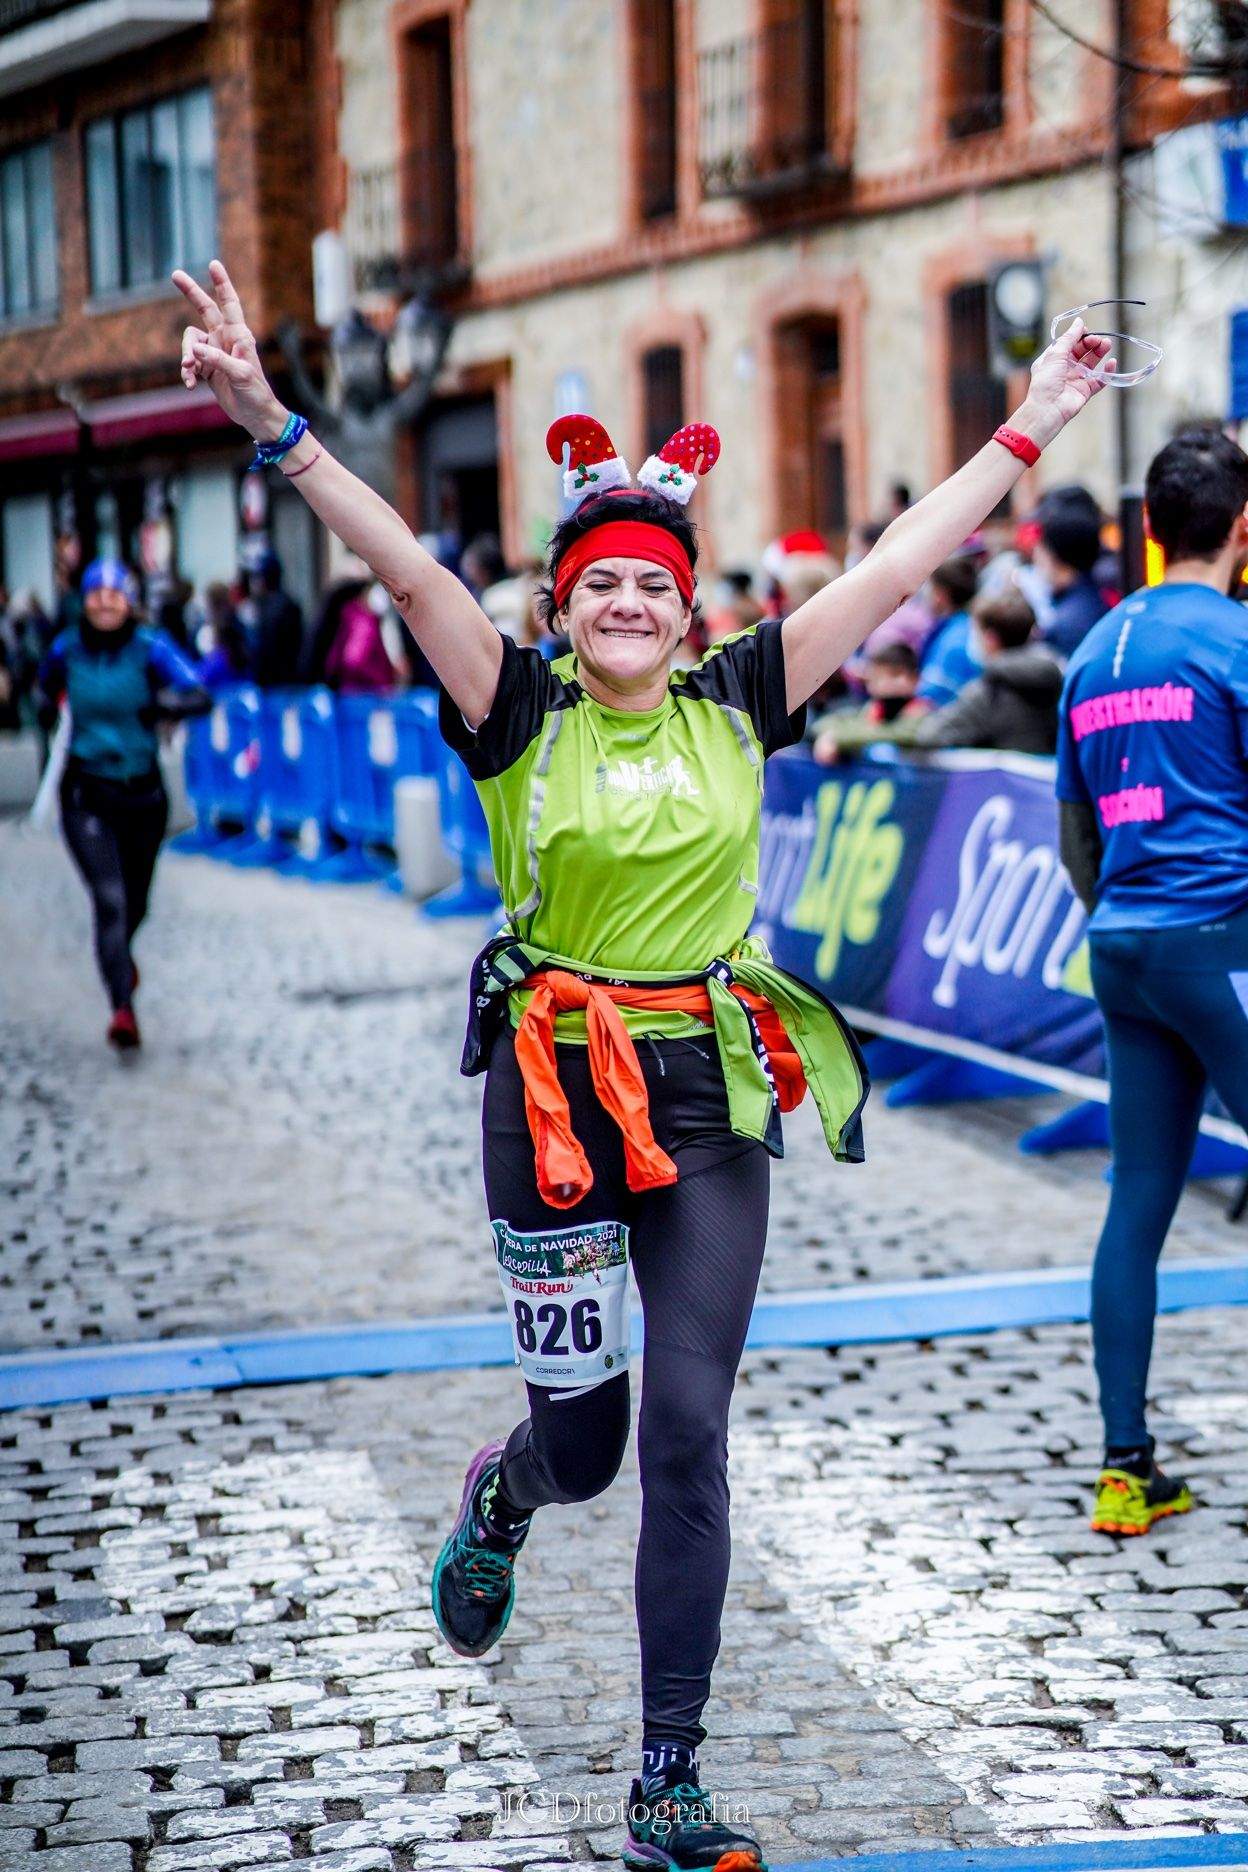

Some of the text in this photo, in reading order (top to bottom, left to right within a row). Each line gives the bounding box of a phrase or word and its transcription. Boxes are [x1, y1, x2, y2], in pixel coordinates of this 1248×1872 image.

[524, 1244, 538, 1253] DE
[540, 1234, 593, 1253] NAVIDAD
[597, 1229, 617, 1242] 2021
[510, 1276, 574, 1296] Trail Run
[513, 1298, 602, 1356] 826
